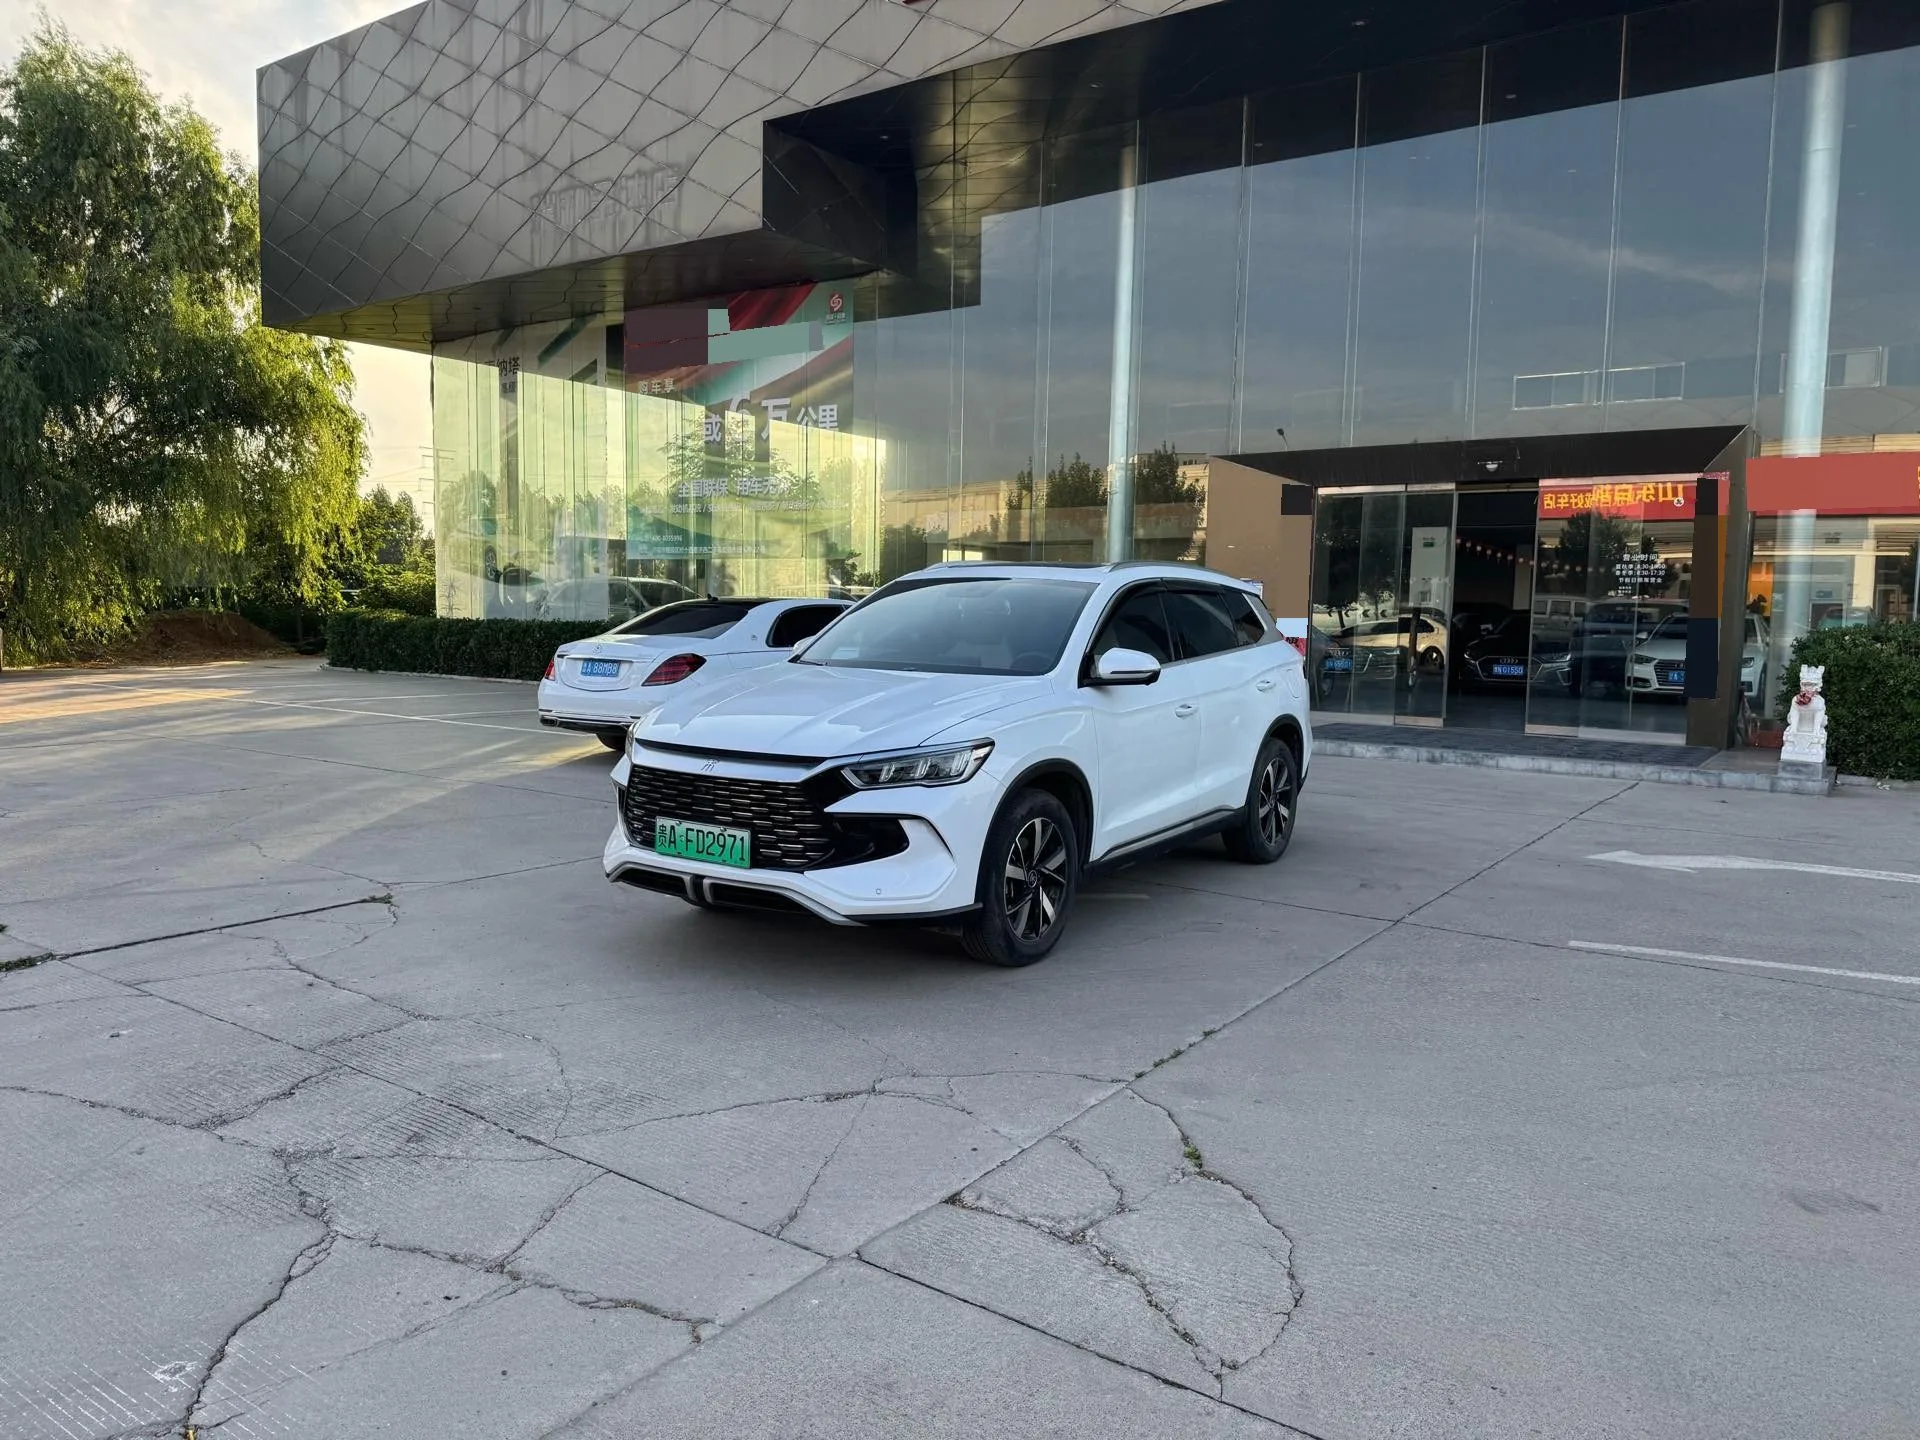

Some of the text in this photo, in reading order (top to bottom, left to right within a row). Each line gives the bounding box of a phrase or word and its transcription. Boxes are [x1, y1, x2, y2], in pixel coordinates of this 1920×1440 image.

[678, 479, 728, 498] 全国联保
[1622, 553, 1657, 561] 营业时间
